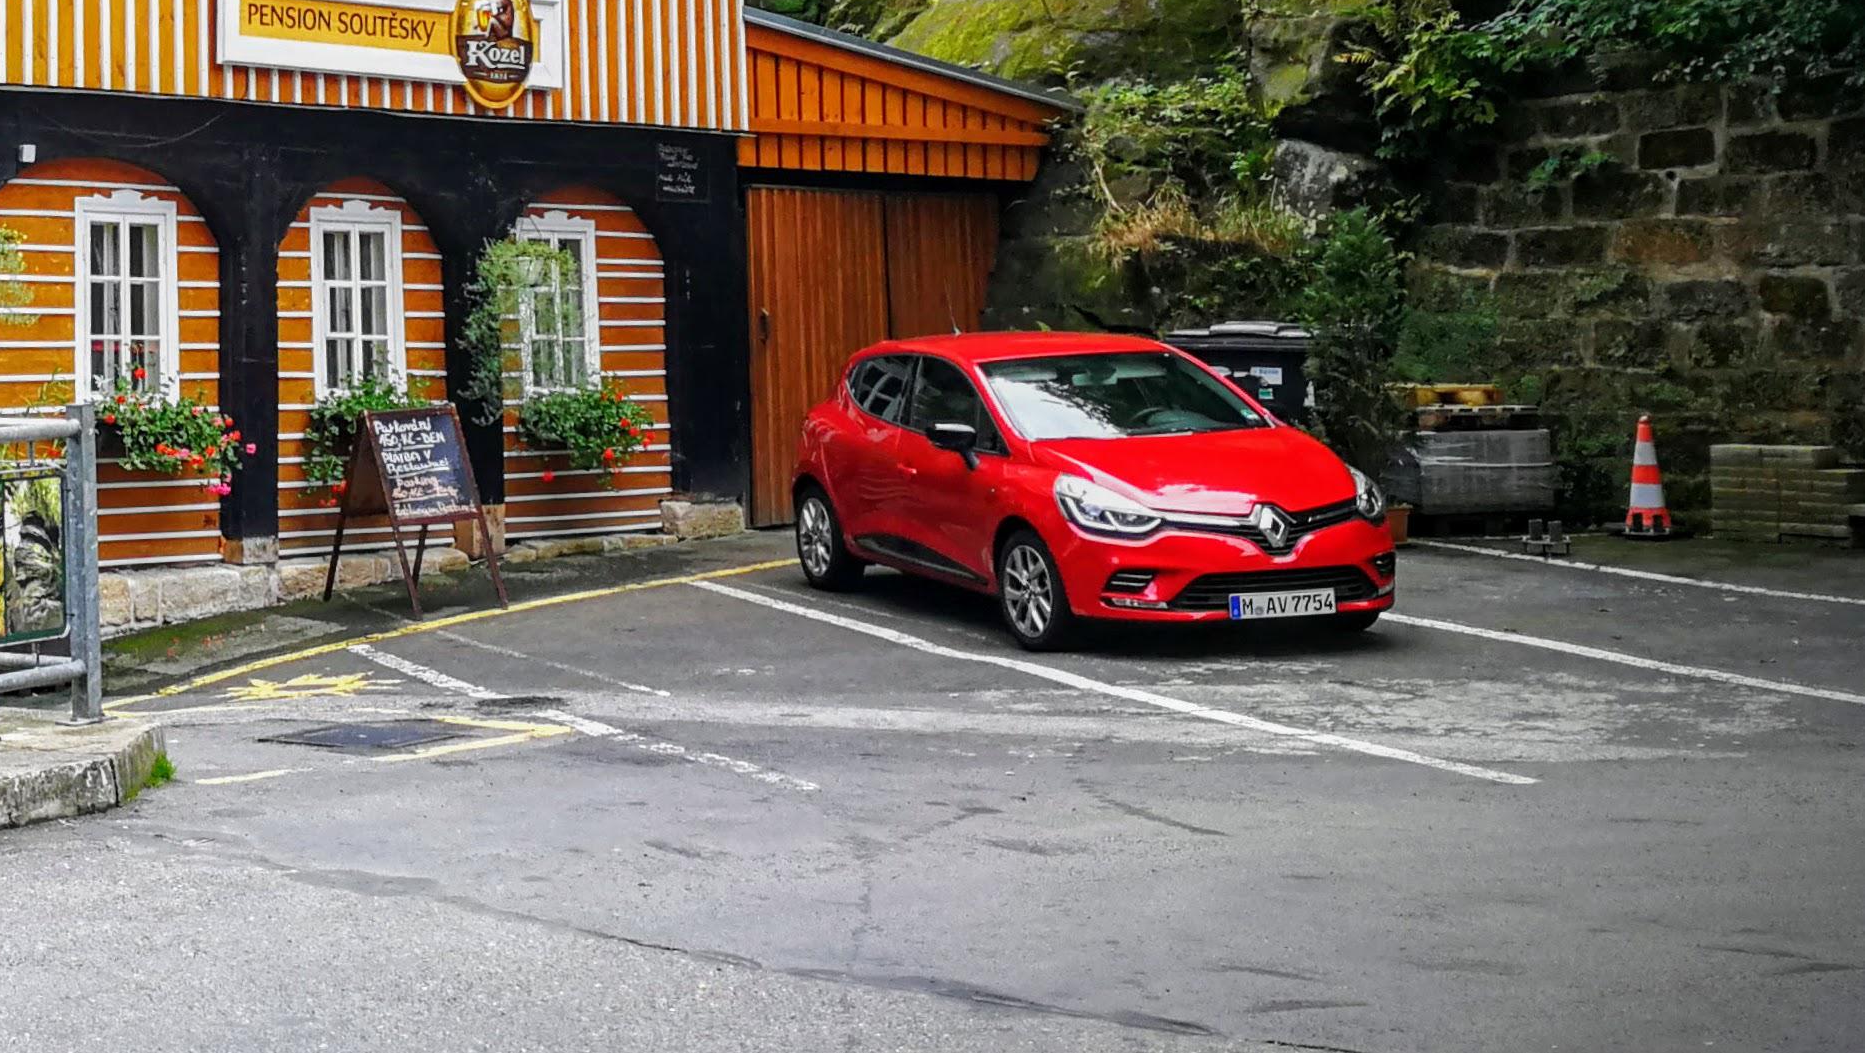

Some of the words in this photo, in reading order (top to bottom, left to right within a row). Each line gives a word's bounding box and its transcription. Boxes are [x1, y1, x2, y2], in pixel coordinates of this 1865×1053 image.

[247, 3, 331, 32] PENSION
[338, 12, 436, 47] SOUTĚSKY
[466, 40, 525, 69] Kozel
[1242, 598, 1254, 615] M
[1266, 597, 1288, 614] AV
[1292, 593, 1333, 612] 7754
